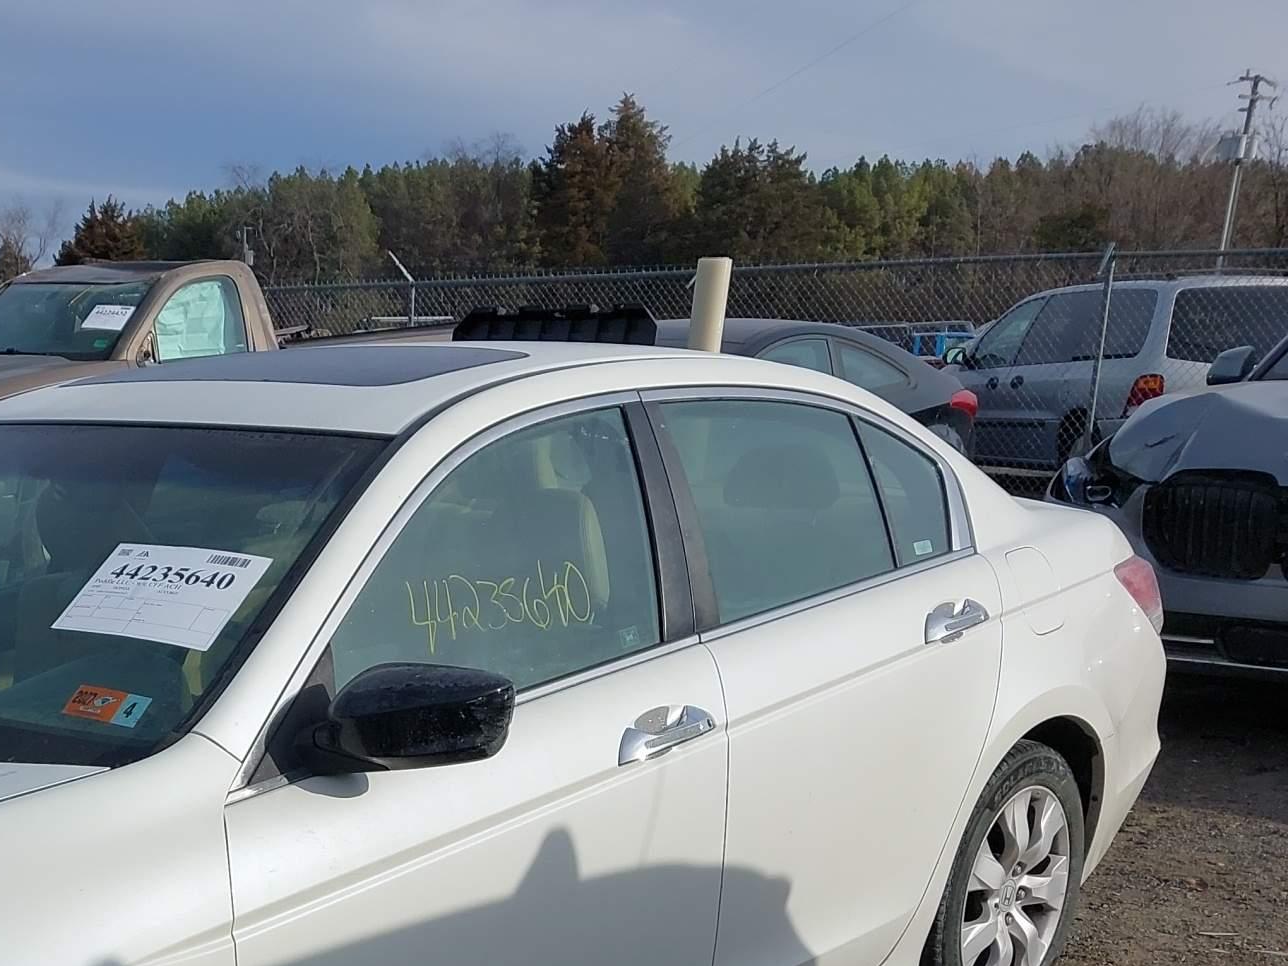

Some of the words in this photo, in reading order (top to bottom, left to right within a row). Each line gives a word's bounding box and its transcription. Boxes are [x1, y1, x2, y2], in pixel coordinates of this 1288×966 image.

[110, 563, 236, 590] 44235640
[405, 559, 594, 654] 44235640
[123, 702, 139, 719] 4
